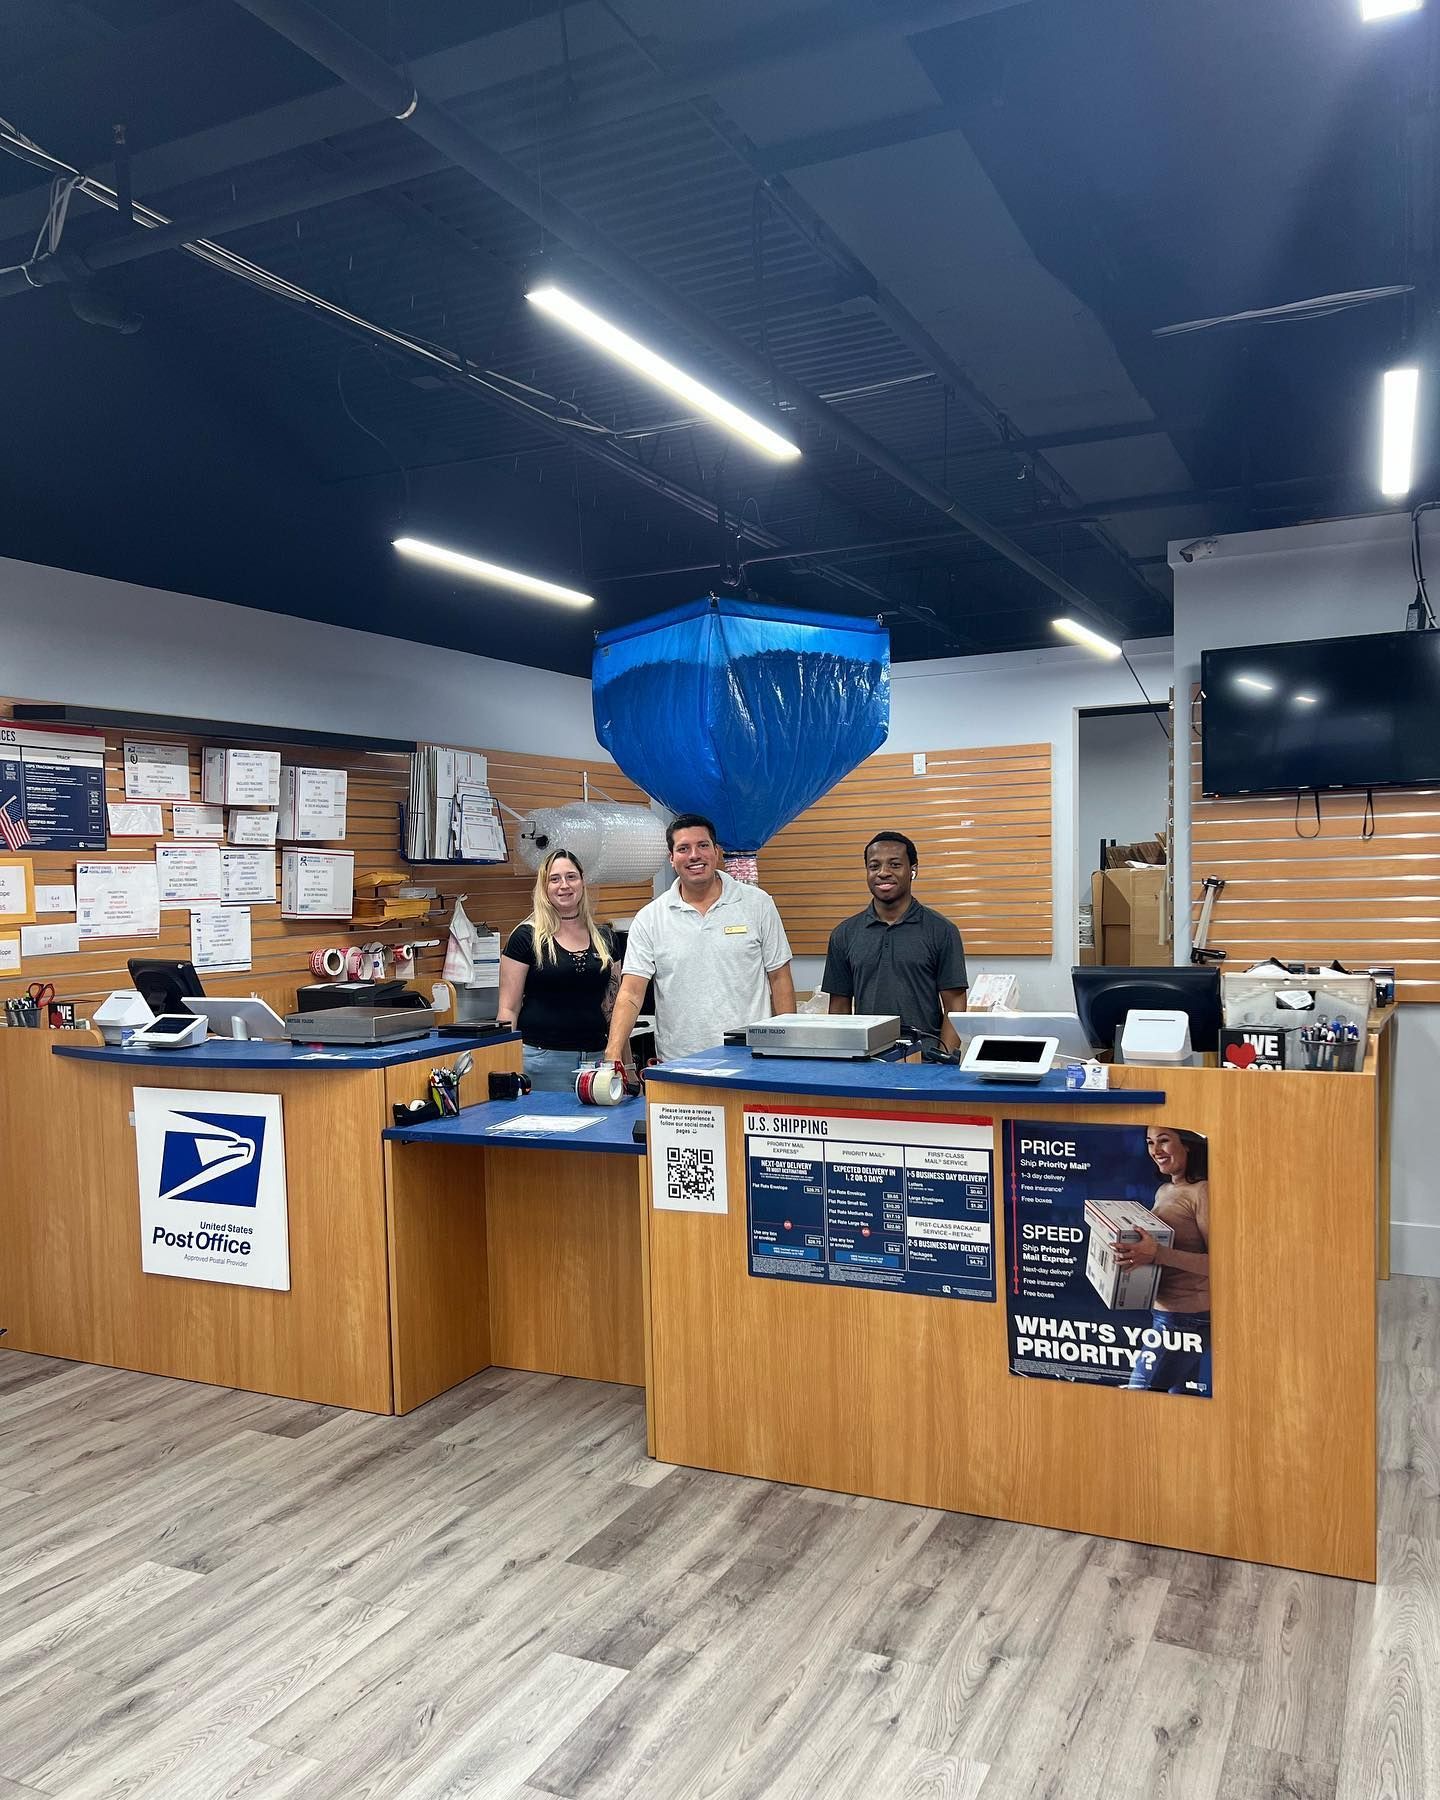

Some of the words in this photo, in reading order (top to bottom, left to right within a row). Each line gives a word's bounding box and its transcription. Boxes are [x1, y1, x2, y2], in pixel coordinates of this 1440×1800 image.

[57, 1005, 72, 1020] WE
[1243, 1034, 1278, 1056] WE
[748, 1116, 769, 1132] U.S.
[774, 1118, 828, 1135] SHIPPING
[1021, 1140, 1076, 1157] PRICE
[761, 1160, 786, 1168] NEXT-DAY
[787, 1162, 812, 1170] DELIVERY
[833, 1165, 861, 1173] EXPECTED
[862, 1167, 888, 1175] DELIVERY
[889, 1169, 896, 1177] IN
[1020, 1159, 1037, 1168] Ship
[1038, 1160, 1068, 1170] Priority
[855, 1174, 863, 1182] OR
[868, 1176, 884, 1184] DAYS
[916, 1171, 945, 1180] BUSINESS
[946, 1173, 957, 1181] DAY
[958, 1174, 987, 1183] DELIVERY
[1044, 1174, 1065, 1182] delivery
[200, 1221, 226, 1232] United
[227, 1224, 253, 1235] States
[1023, 1224, 1083, 1243] SPEED
[153, 1226, 194, 1249] Post
[196, 1232, 251, 1255] Office
[908, 1239, 917, 1247] 2-5
[919, 1240, 947, 1250] BUSINESS
[948, 1243, 960, 1252] DAY
[961, 1244, 989, 1254] DELIVERY
[1023, 1244, 1039, 1252] Ship
[1041, 1245, 1070, 1256] Priority
[1023, 1253, 1040, 1261] Mail
[184, 1254, 208, 1263] Approved
[226, 1259, 248, 1268] Provider
[1023, 1266, 1048, 1275] Next-day
[1037, 1290, 1055, 1299] boxes
[1014, 1315, 1116, 1344] WHAT'S
[1123, 1326, 1203, 1354] YOUR
[1016, 1337, 1157, 1371] PRIORITY?
